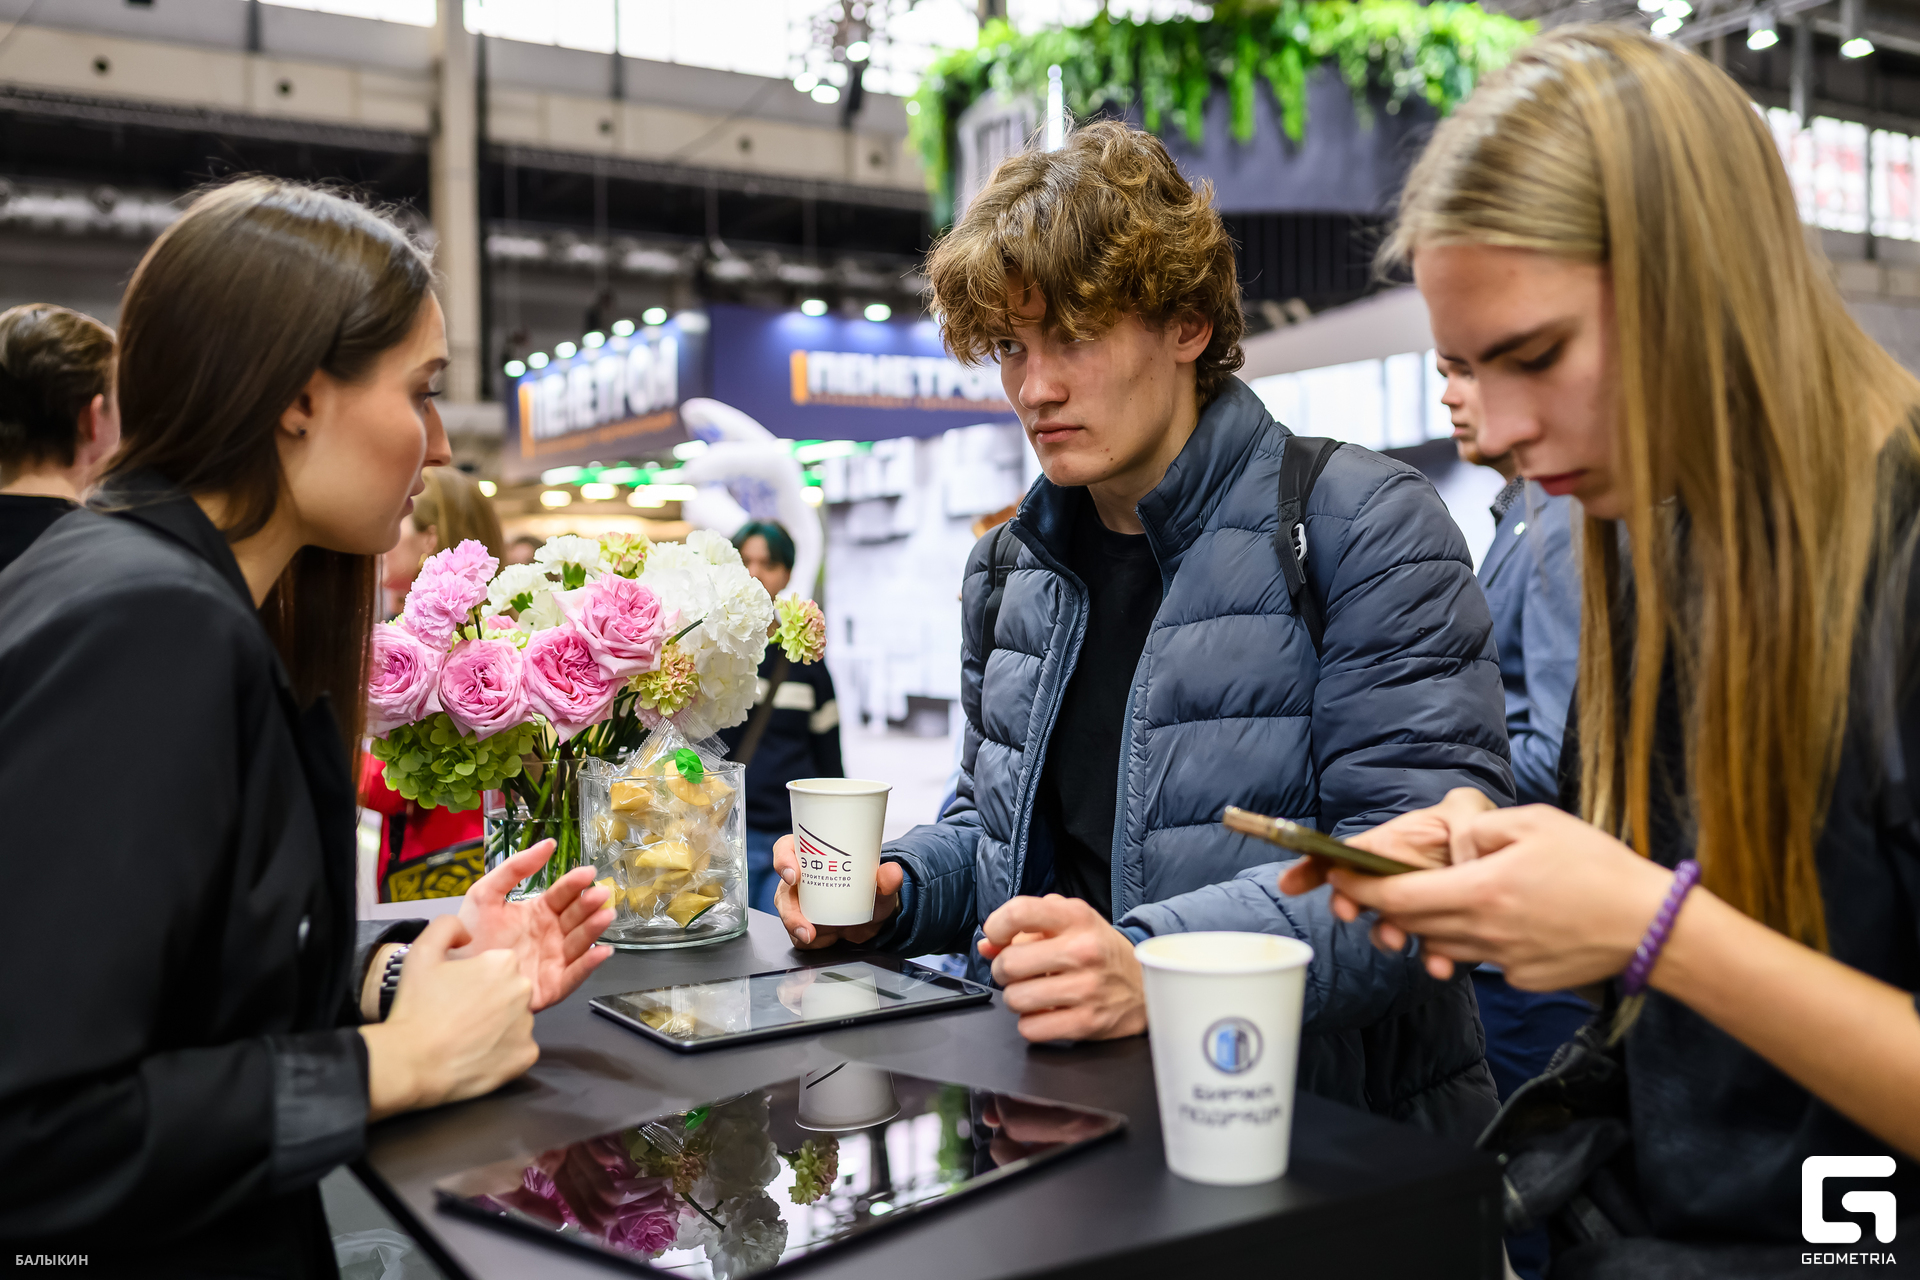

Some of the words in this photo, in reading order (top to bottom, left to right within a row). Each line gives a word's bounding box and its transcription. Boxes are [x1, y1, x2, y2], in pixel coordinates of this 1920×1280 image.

[801, 857, 852, 872] ЭФЕС
[801, 872, 852, 881] СТРОИТЕЛЬСТВО
[807, 880, 851, 888] АРХИТЕКТУРА
